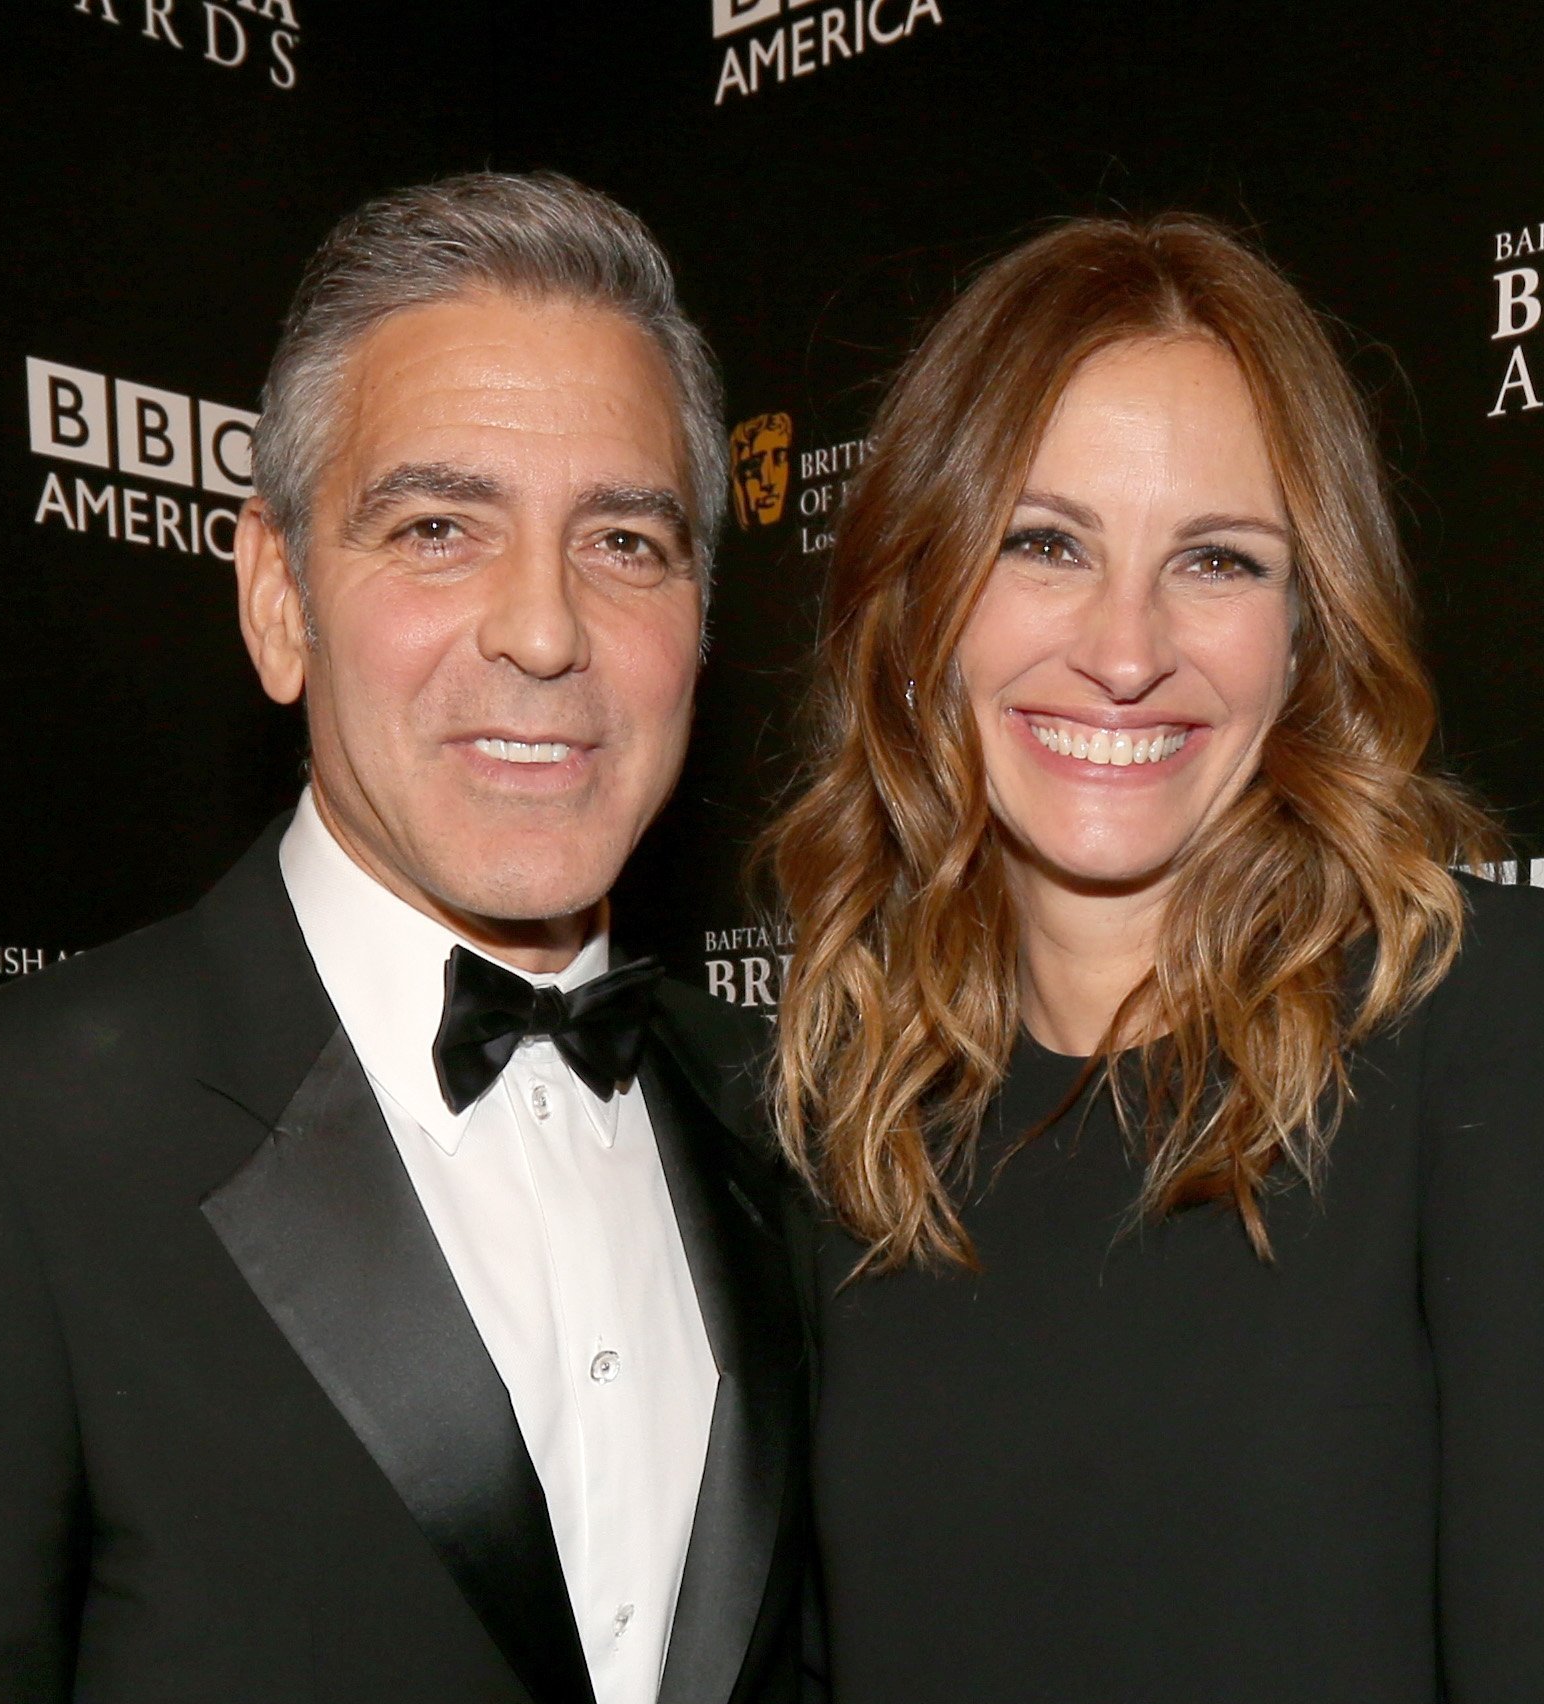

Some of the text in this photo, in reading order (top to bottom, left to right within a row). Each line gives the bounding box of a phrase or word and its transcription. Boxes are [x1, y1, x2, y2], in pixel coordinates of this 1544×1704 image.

[73, 0, 299, 91] RDS
[713, 0, 944, 107] AMERICA
[48, 376, 259, 486] BBC
[34, 471, 236, 562] AMERIC
[706, 927, 772, 952] BAFTA
